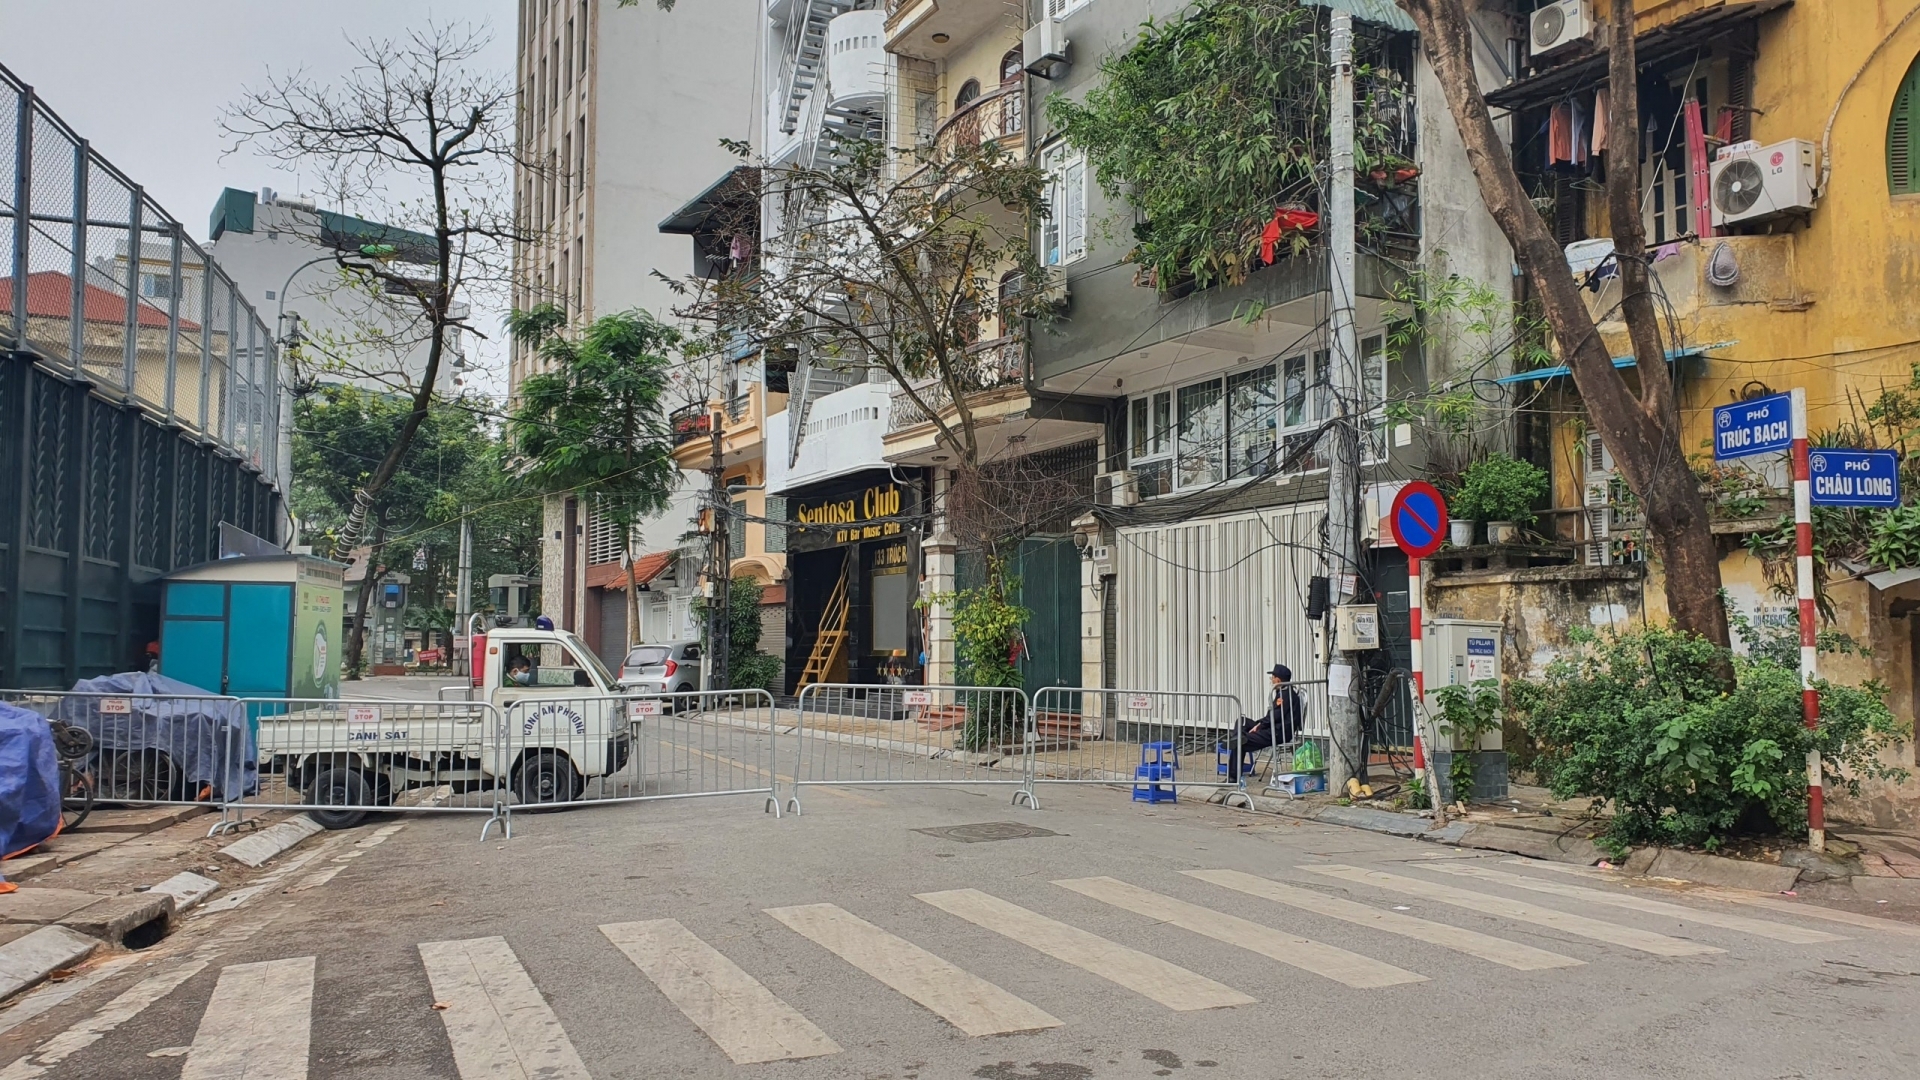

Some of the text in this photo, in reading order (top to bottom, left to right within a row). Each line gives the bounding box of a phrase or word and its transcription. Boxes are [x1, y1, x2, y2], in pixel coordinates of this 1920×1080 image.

[1771, 166, 1783, 175] LG
[1746, 404, 1770, 421] PHỐ
[1720, 420, 1788, 450] TRÚC BẠCH
[1844, 458, 1870, 471] PHỐ
[1815, 473, 1892, 496] CHÂU LONG
[798, 483, 900, 532] Sentosa Club
[836, 529, 848, 543] KTV
[850, 528, 860, 541] Bar
[874, 548, 885, 566] 133
[886, 543, 902, 565] TRÚC
[541, 705, 555, 716] AN
[384, 729, 408, 740] SÁT
